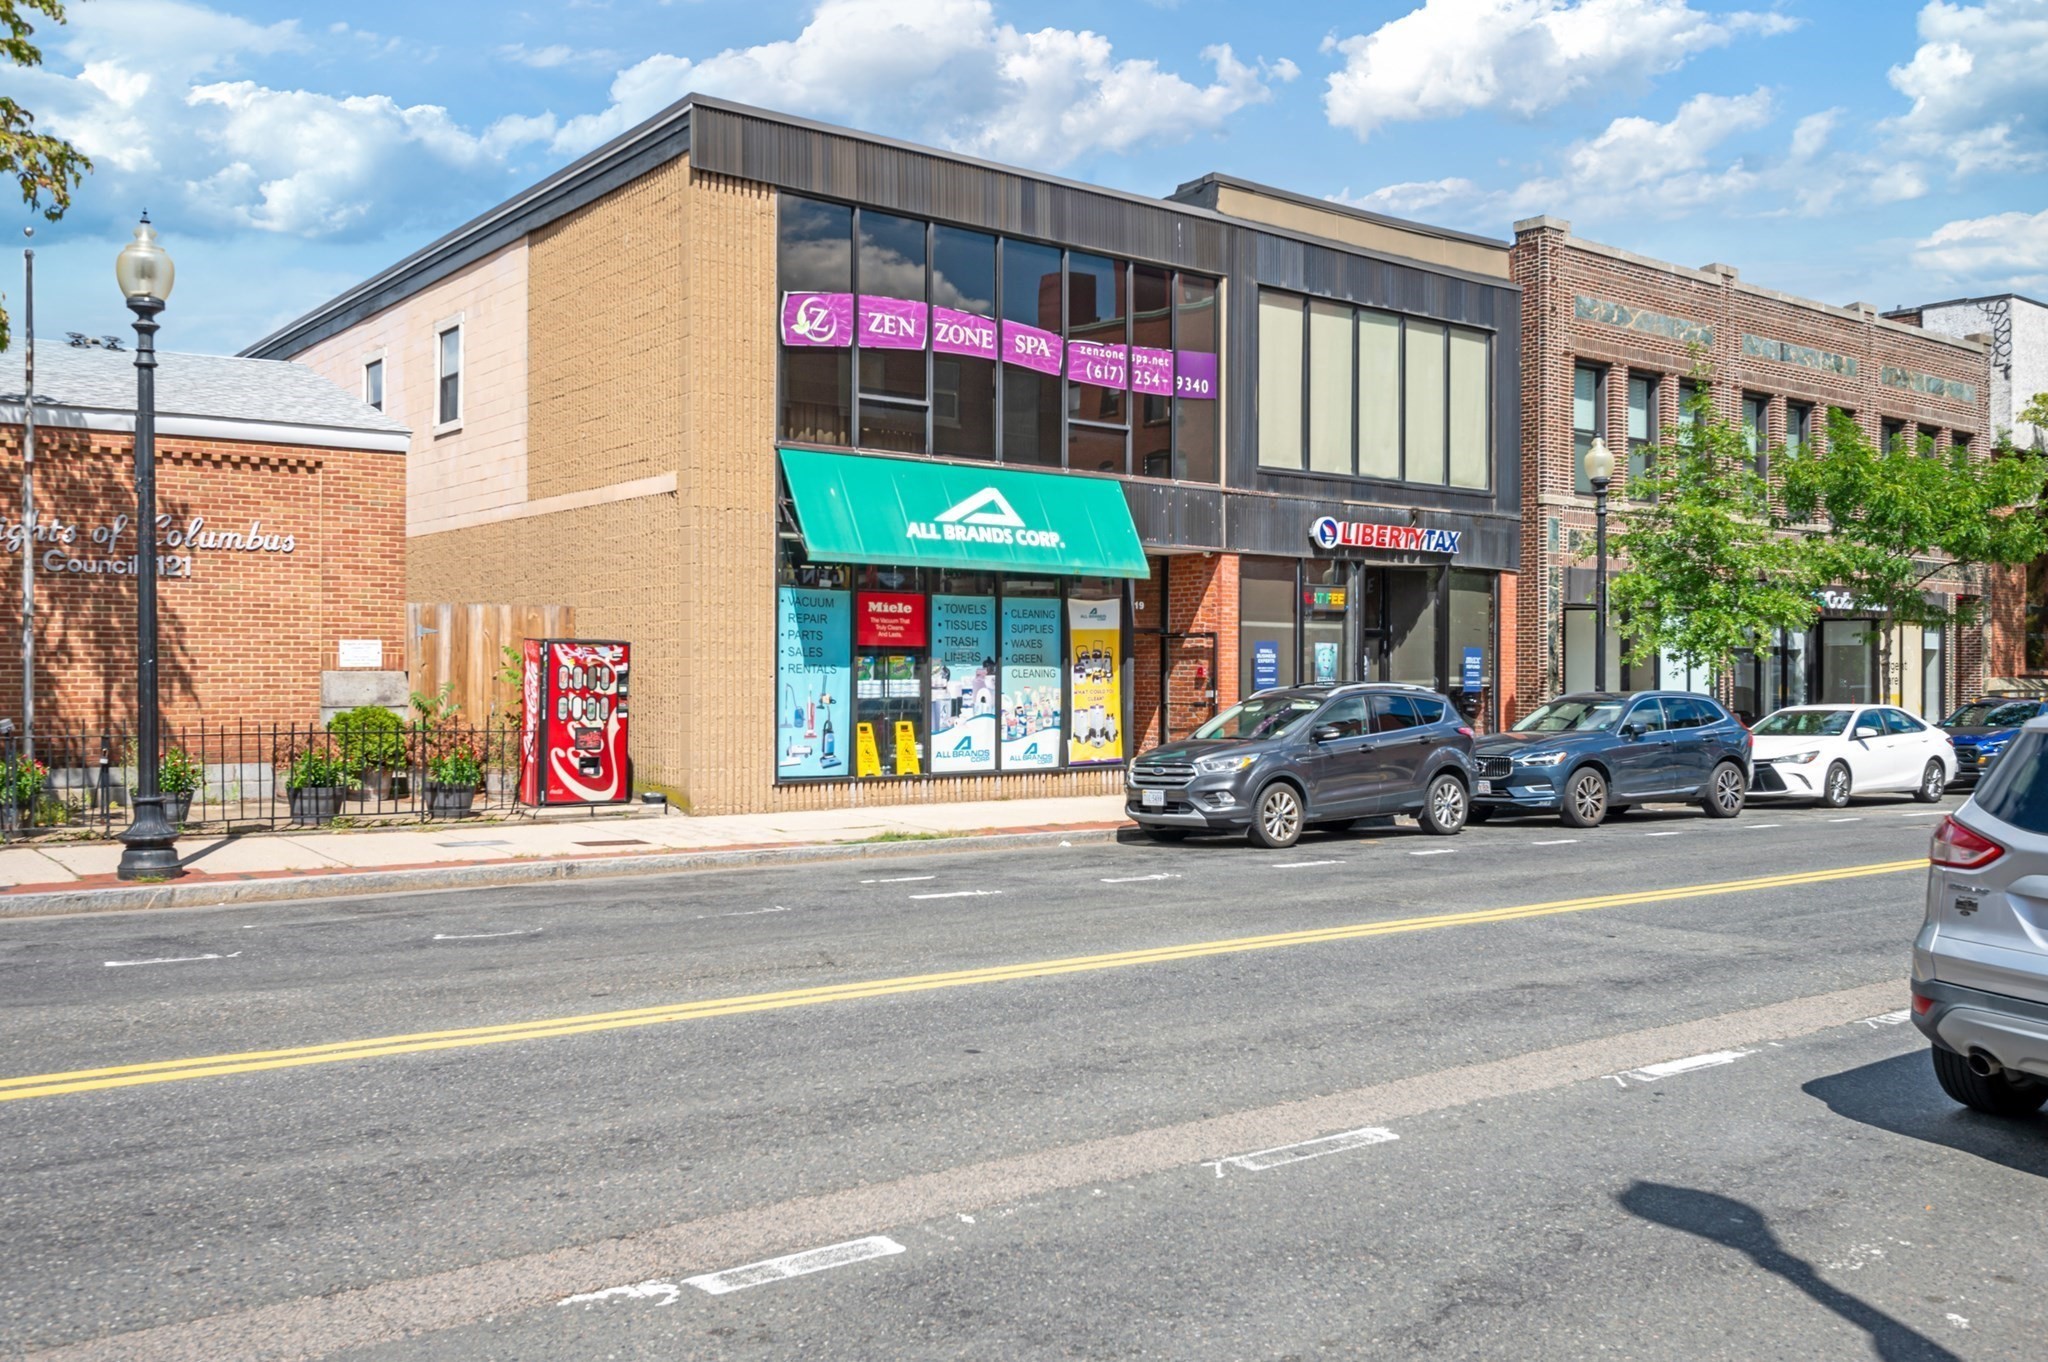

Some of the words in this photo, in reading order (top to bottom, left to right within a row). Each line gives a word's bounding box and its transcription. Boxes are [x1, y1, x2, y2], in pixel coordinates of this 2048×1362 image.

[867, 312, 917, 337] ZEN
[934, 322, 994, 349] ZONE
[1014, 334, 1052, 357] SPA
[1086, 361, 1125, 383] (617)
[92, 514, 128, 553] of
[906, 522, 941, 540] ALL
[943, 524, 1014, 545] BRANDS
[1015, 530, 1067, 549] CORP.
[42, 550, 138, 575] Council
[156, 555, 192, 577] 121
[788, 597, 835, 608] VACUUM
[1326, 592, 1345, 605] FEE
[868, 601, 912, 614] Miele
[944, 604, 987, 615] TOWELS
[788, 613, 828, 624] REPAIR
[1011, 609, 1056, 619] CLEANING
[944, 620, 988, 631] TISSUES
[1011, 624, 1054, 634] SUPPLIES
[788, 630, 824, 641] PARTS
[944, 636, 979, 647] TRASH
[1011, 639, 1043, 648] WAXES
[788, 647, 823, 658] SALES
[944, 651, 981, 662] LINERS
[1011, 654, 1043, 664] GREEN
[788, 664, 837, 675] RENTALS
[1011, 669, 1056, 678] CLEANING
[935, 750, 951, 758] ALL
[952, 749, 990, 758] BRANDS
